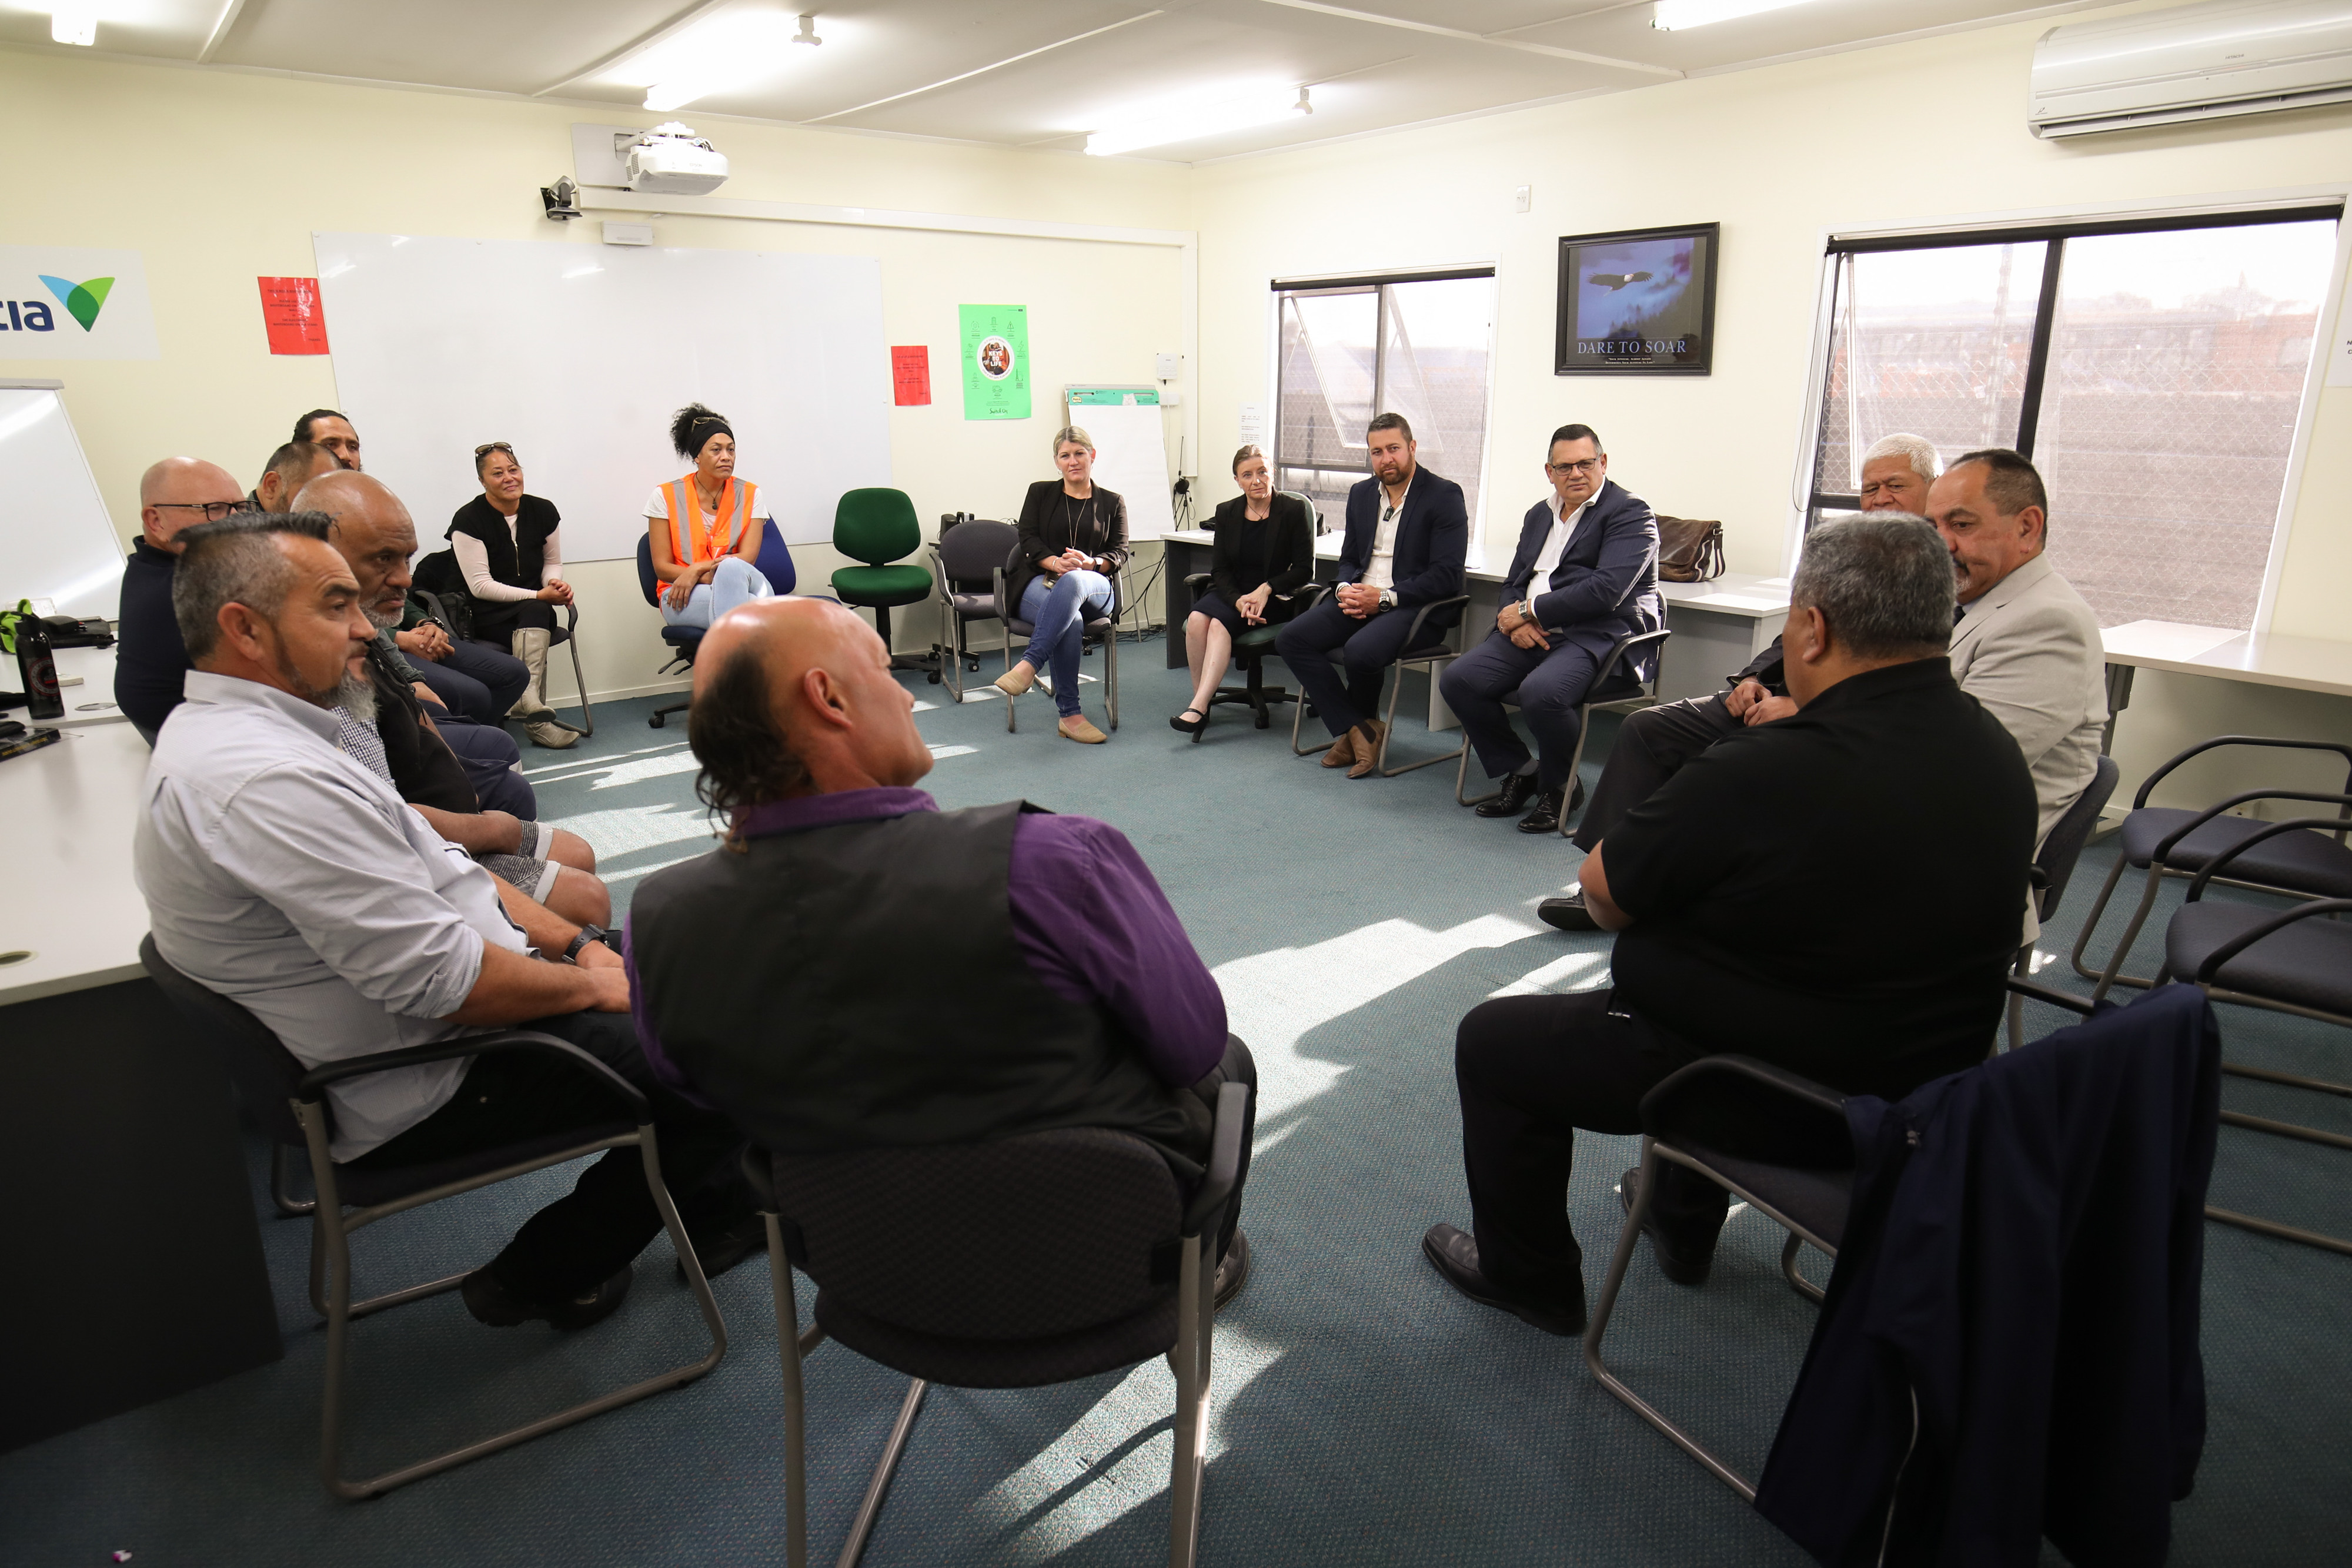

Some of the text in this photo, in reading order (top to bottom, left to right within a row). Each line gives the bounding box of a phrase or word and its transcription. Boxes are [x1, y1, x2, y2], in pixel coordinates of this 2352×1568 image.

[1578, 340, 1686, 354] DARE TO SOAR
